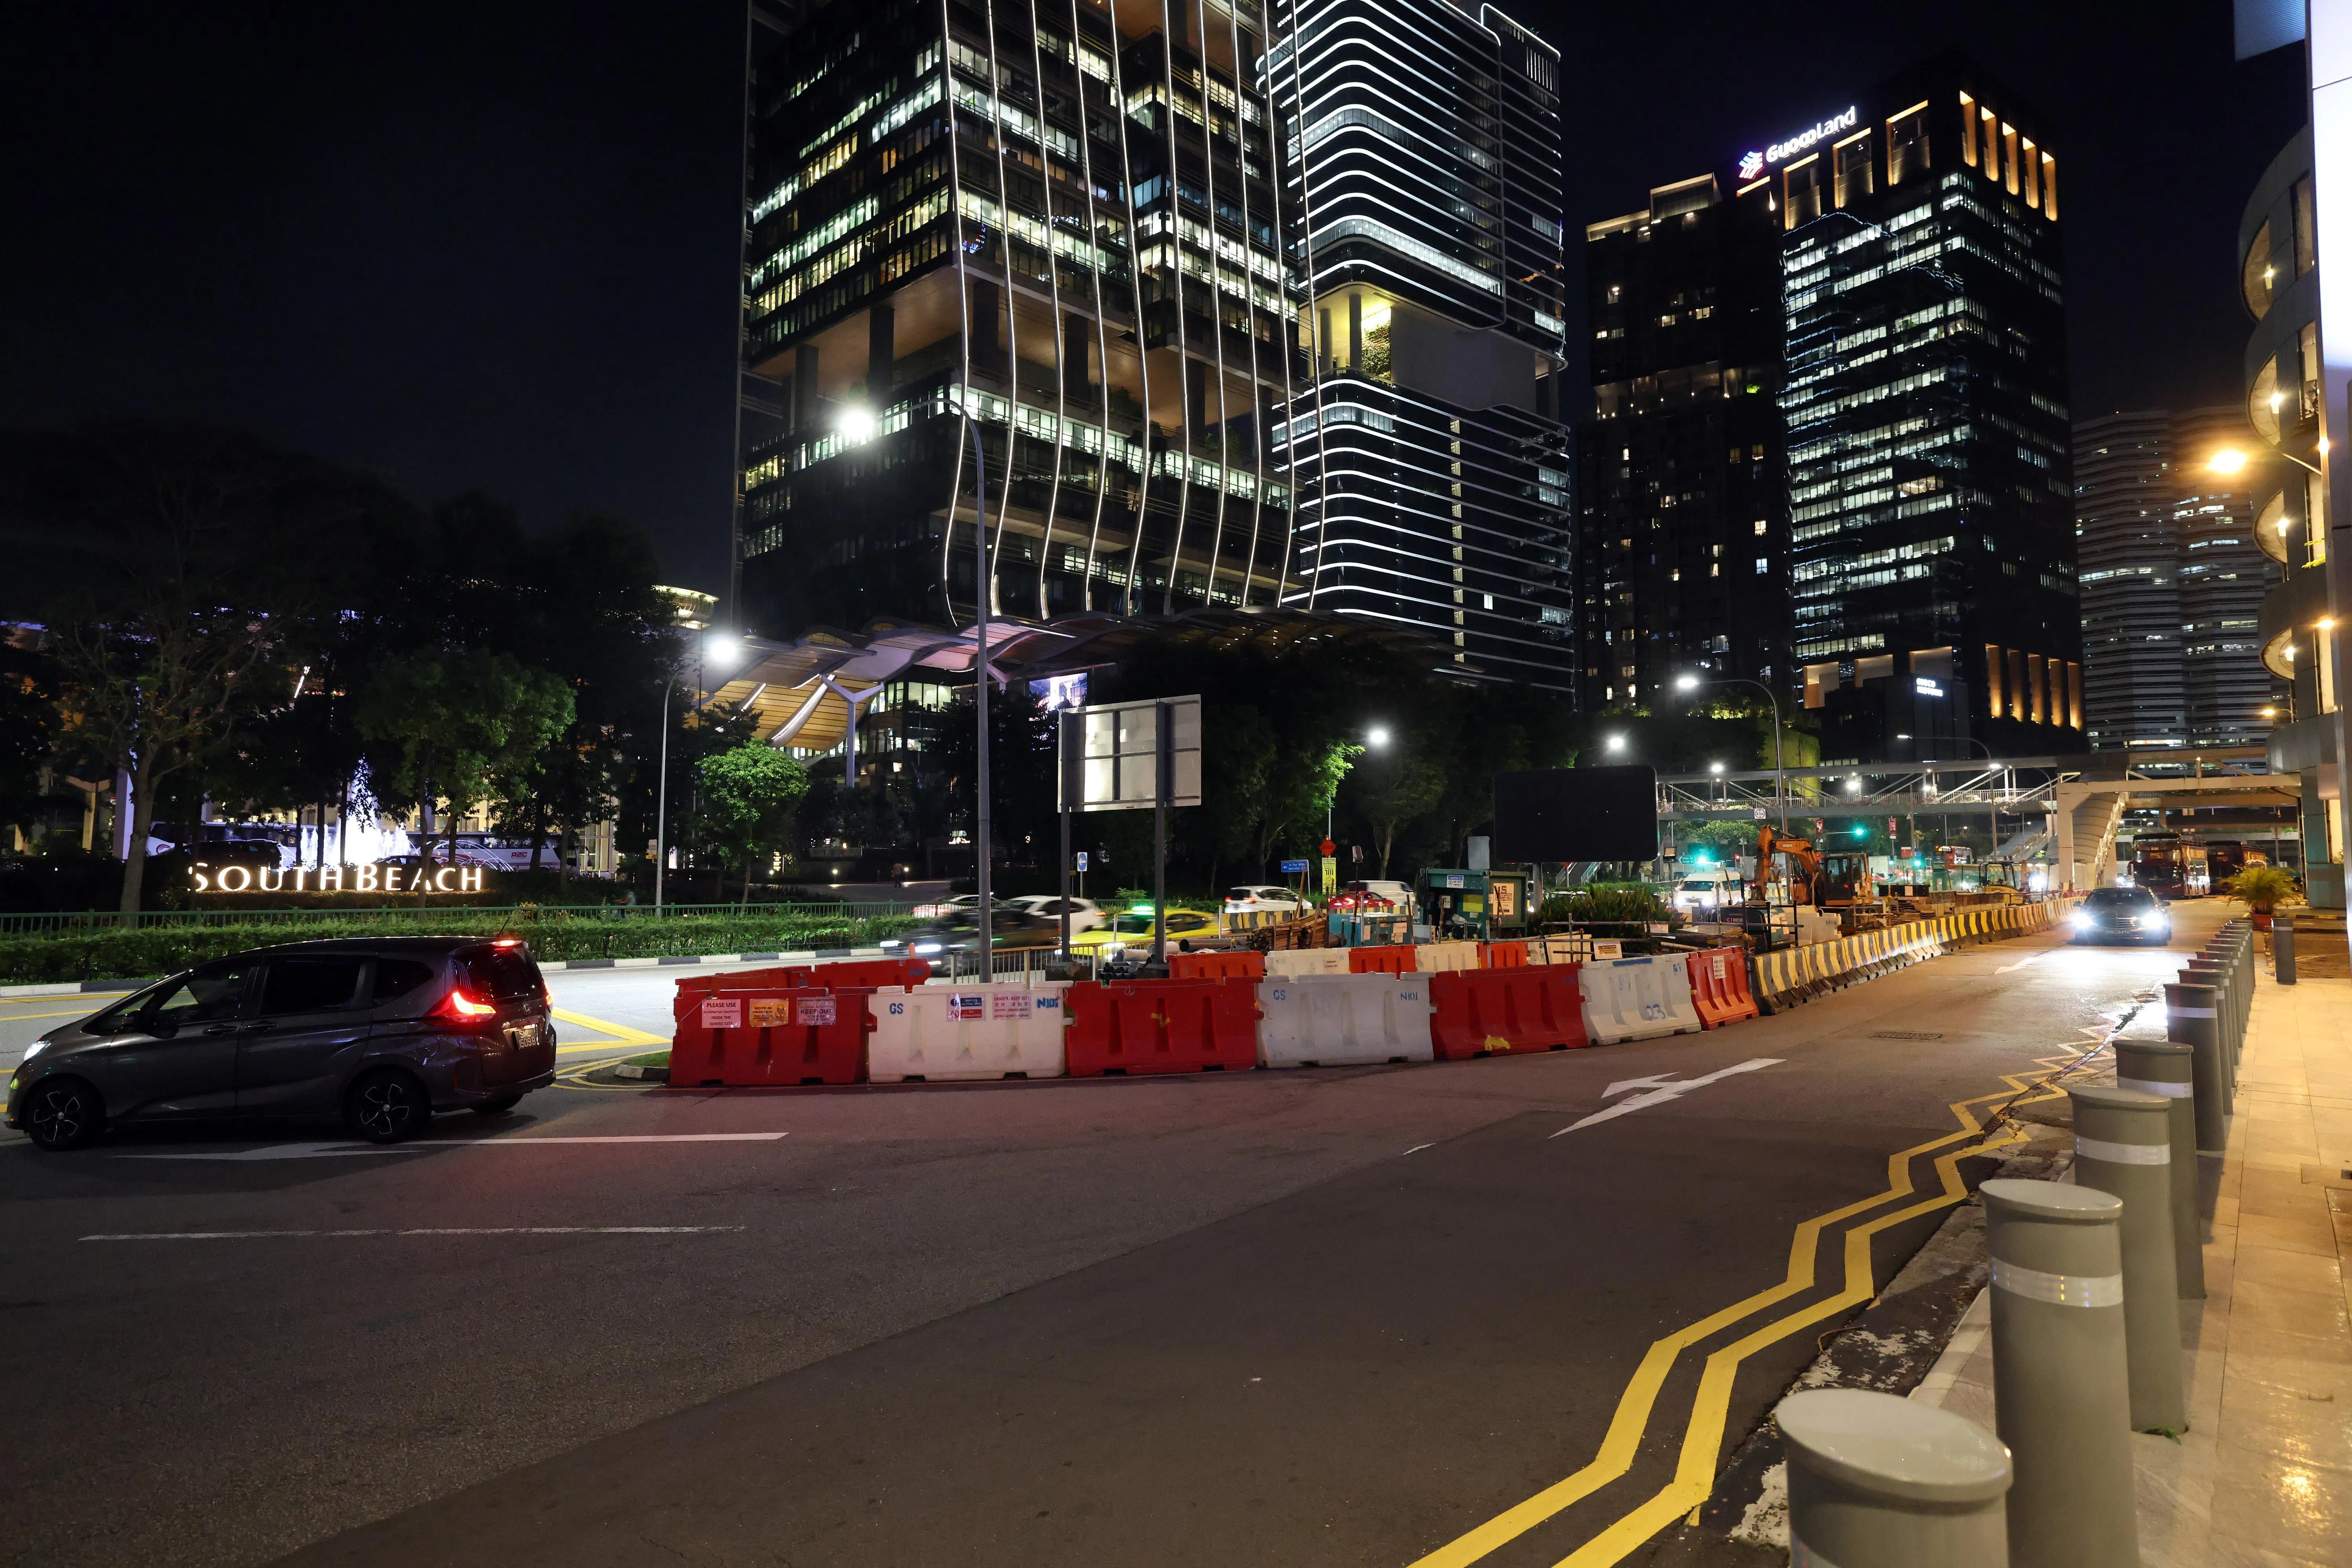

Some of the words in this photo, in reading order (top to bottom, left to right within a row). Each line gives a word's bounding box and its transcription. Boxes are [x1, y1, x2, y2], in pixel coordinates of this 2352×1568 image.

[1766, 106, 1857, 162] GuocoLand
[188, 862, 342, 891] SOUTH
[357, 862, 482, 891] BEACH
[889, 1003, 904, 1014] GS
[519, 1029, 532, 1038] SML
[518, 1037, 536, 1048] 1509B
